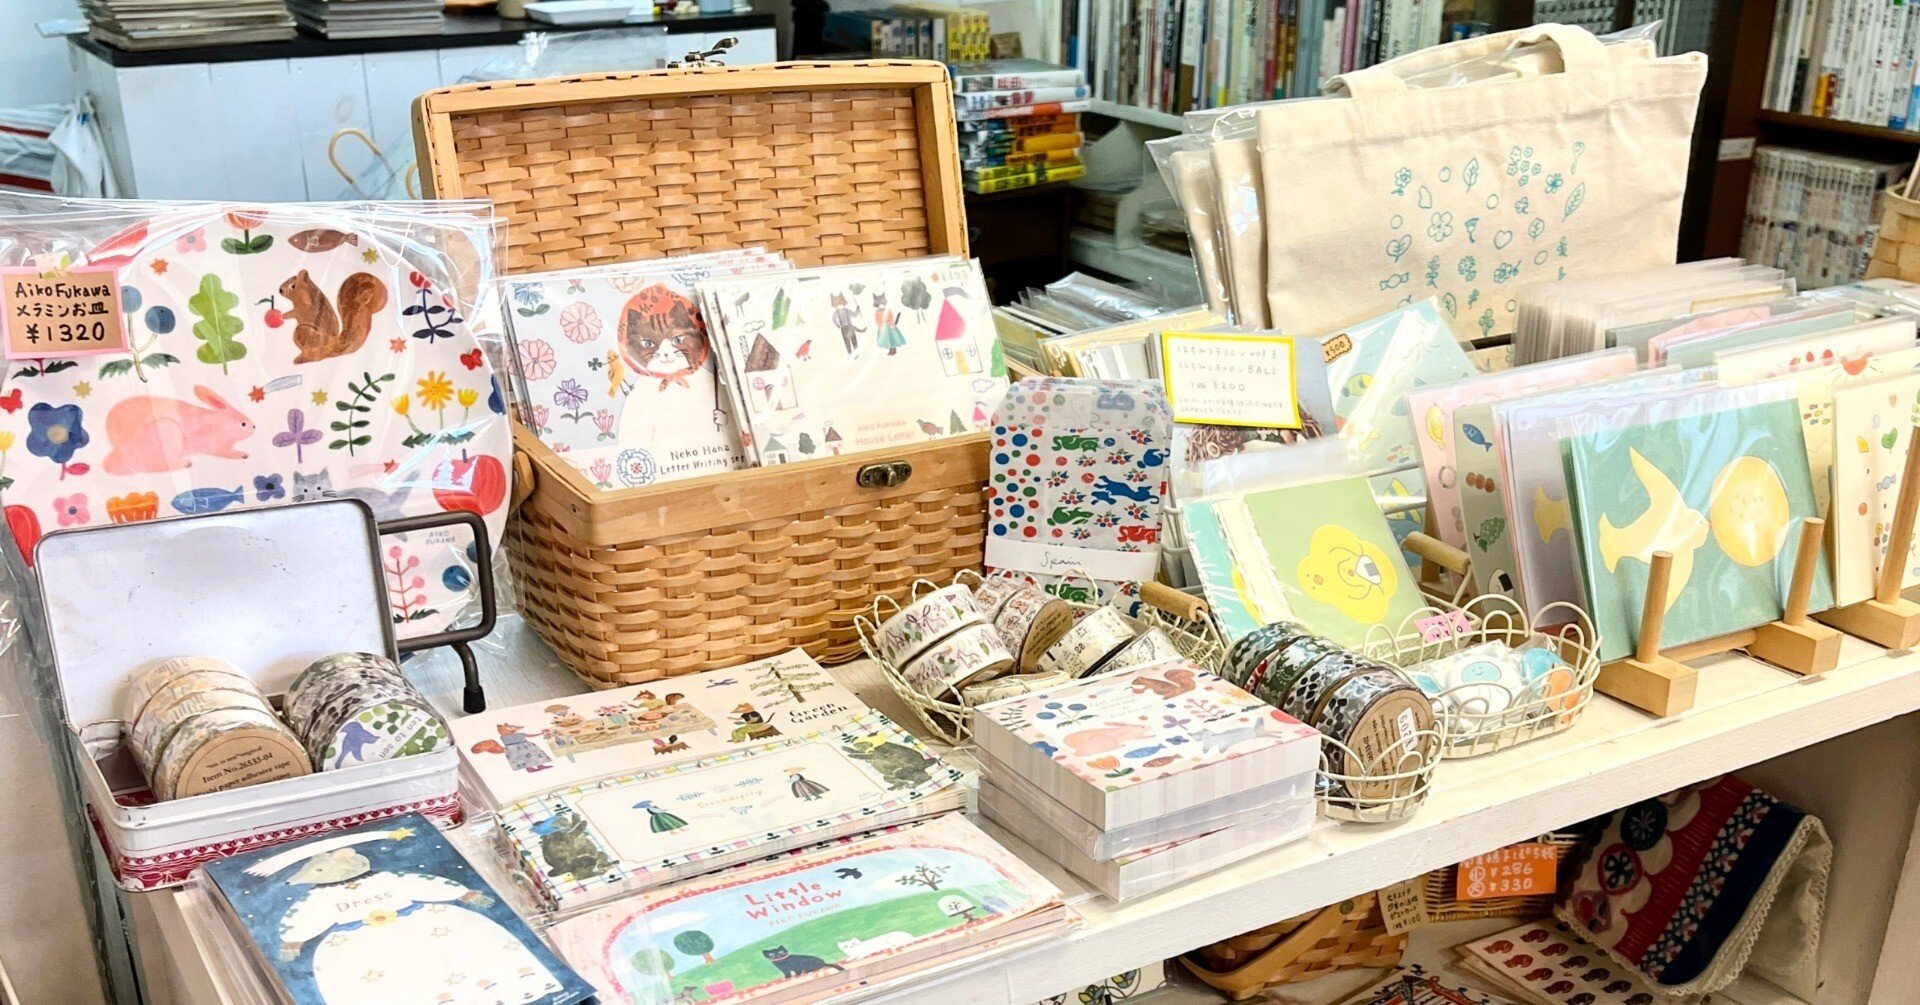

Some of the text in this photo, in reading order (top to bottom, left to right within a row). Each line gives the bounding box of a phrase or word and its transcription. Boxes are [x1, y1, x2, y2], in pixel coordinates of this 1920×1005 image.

[16, 302, 109, 318] メラミンお皿
[26, 321, 105, 344] ¥1320
[1248, 365, 1277, 376] BALI
[1213, 379, 1246, 392] ¥200
[855, 431, 914, 446] House Letter
[671, 444, 730, 460] Neko Hana
[660, 463, 690, 475] Letter
[693, 457, 728, 470] Writing
[426, 537, 456, 545] FUKAWA
[429, 530, 450, 538] AIKO
[1040, 551, 1082, 570] Spain
[790, 702, 837, 717] Green
[791, 705, 849, 724] Garden
[409, 716, 423, 730] ten
[380, 744, 394, 758] sen
[202, 771, 223, 784] Item
[219, 778, 240, 793] paper
[241, 767, 273, 782] adhesive
[274, 760, 291, 772] tape
[697, 790, 763, 808] Serendipity
[1491, 862, 1534, 878] ¥286
[1489, 878, 1533, 893] ¥330
[336, 891, 393, 912] Dress
[745, 882, 821, 906] Little
[746, 889, 842, 920] Window
[769, 904, 841, 927] AIKO FUKAWA
[1403, 913, 1421, 926] ¥100
